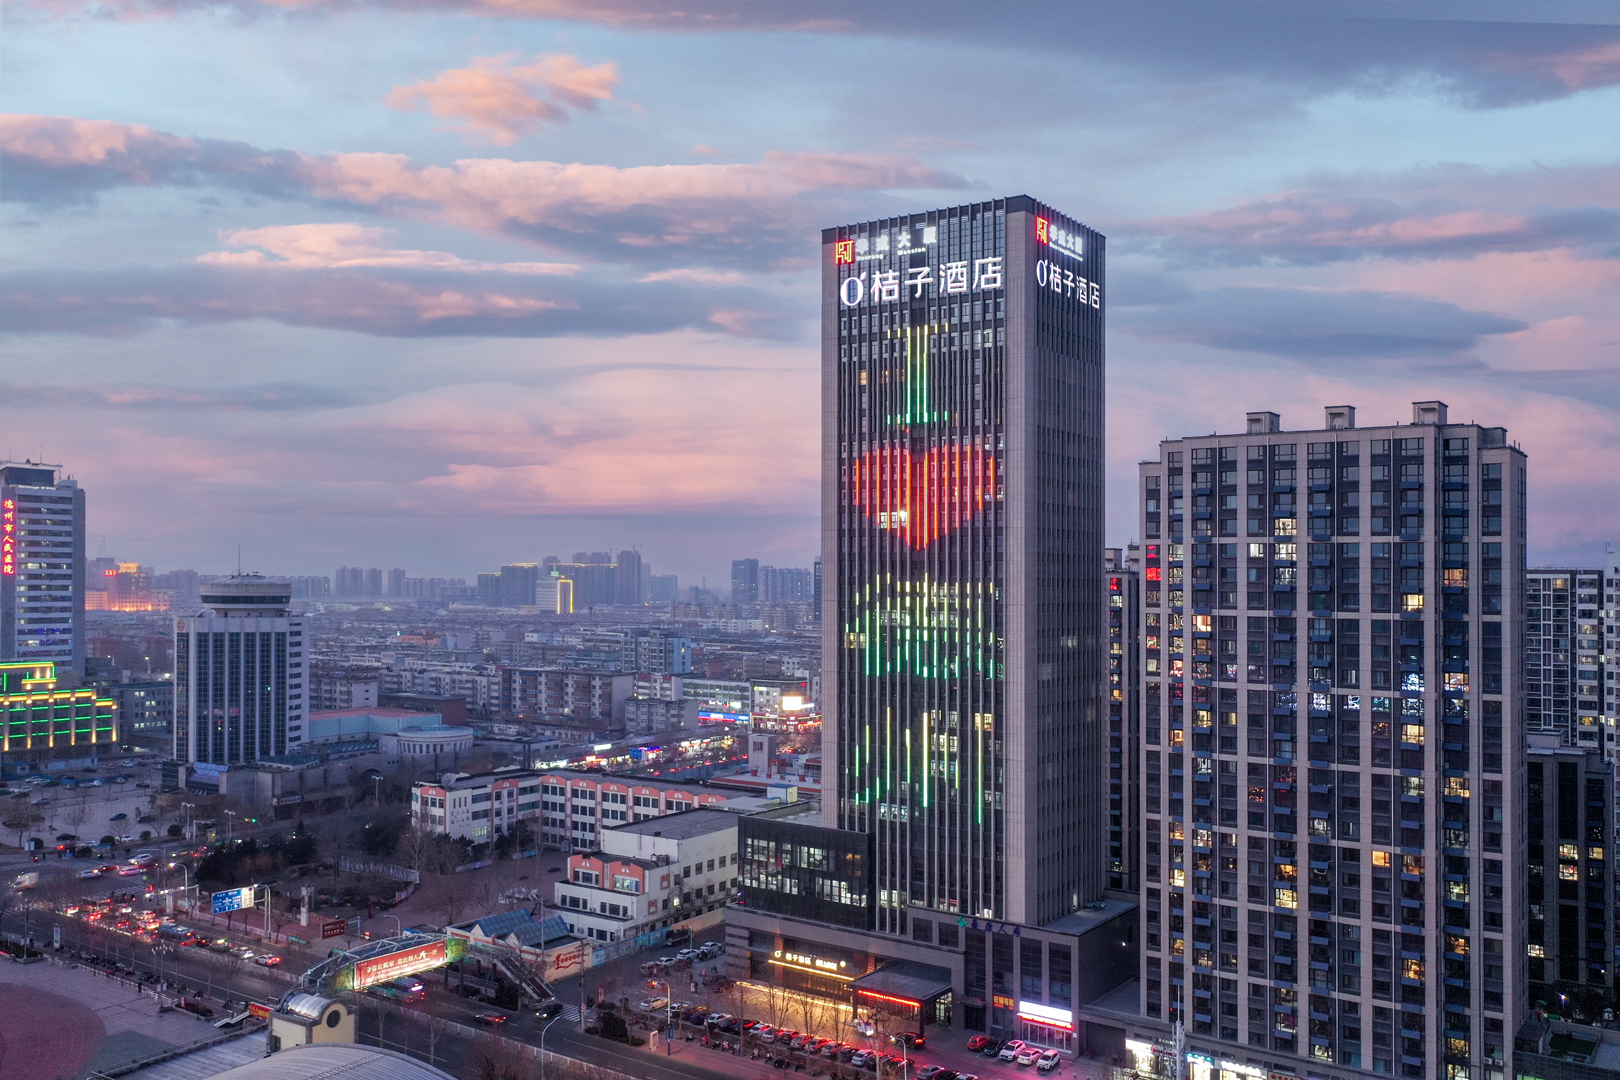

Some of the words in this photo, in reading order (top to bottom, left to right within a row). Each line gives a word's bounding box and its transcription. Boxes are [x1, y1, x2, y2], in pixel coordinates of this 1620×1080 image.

[870, 257, 1002, 303] 桔子酒店
[1049, 262, 1100, 310] 桔子酒店
[3, 499, 15, 575] 德州市人民医院
